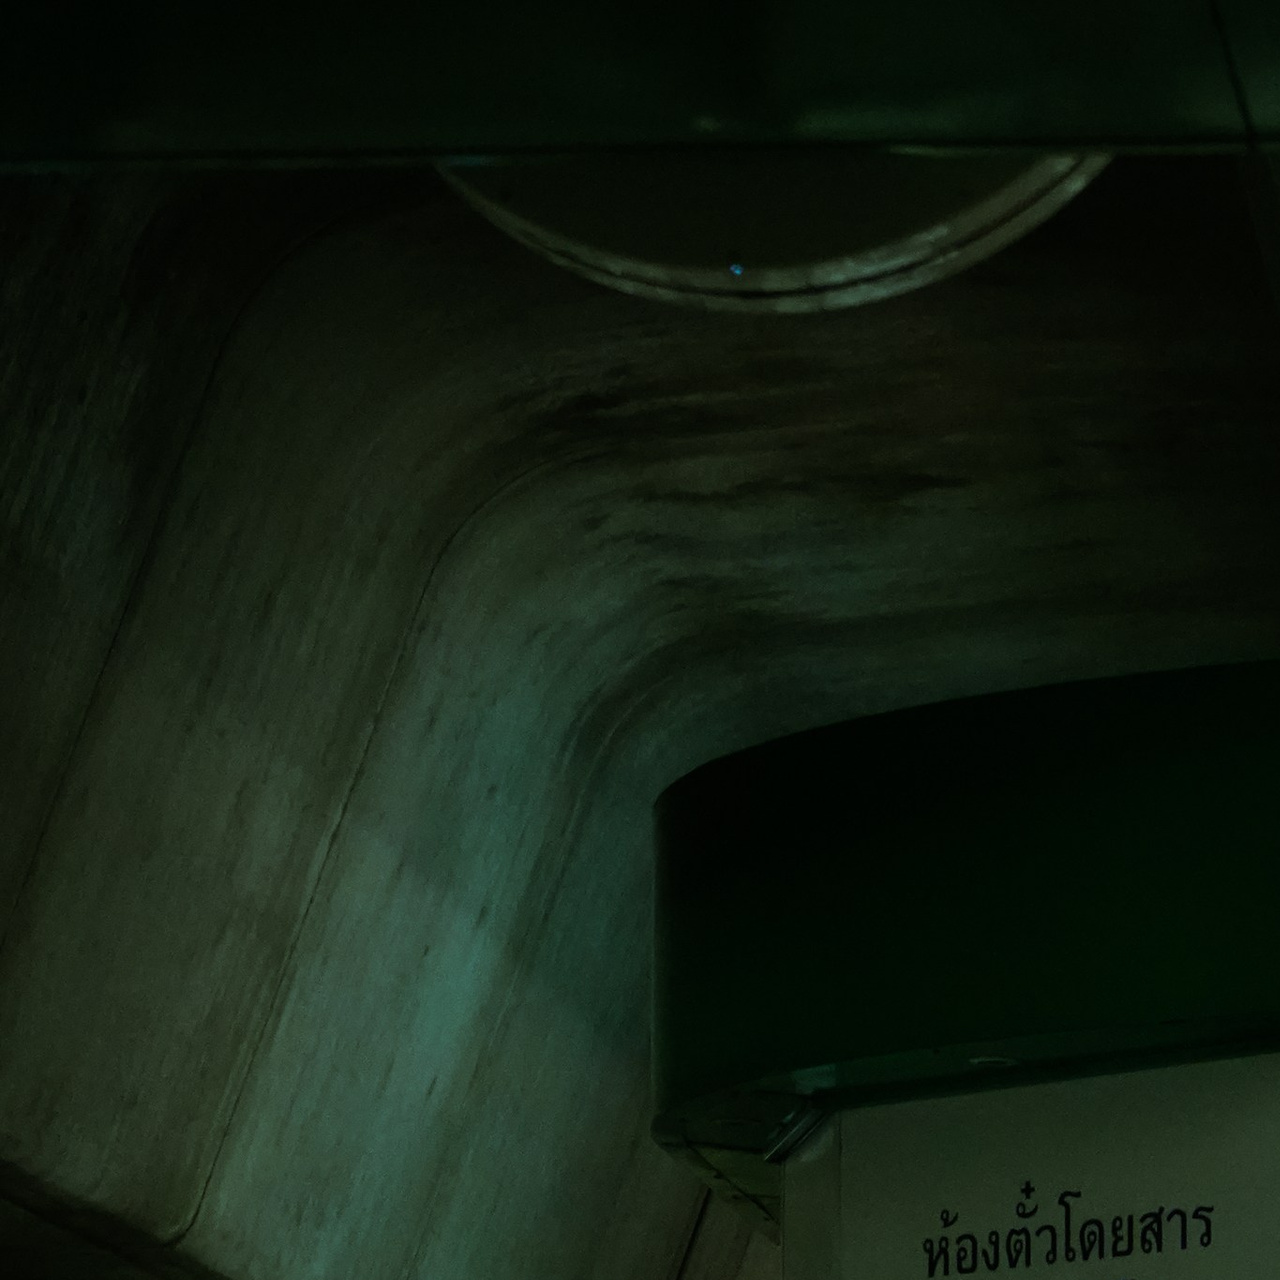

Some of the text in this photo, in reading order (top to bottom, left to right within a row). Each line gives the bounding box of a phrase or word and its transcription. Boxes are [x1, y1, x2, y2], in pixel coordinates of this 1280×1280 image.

[923, 1180, 1215, 1279] ห้องตั๋วโดยสาร
